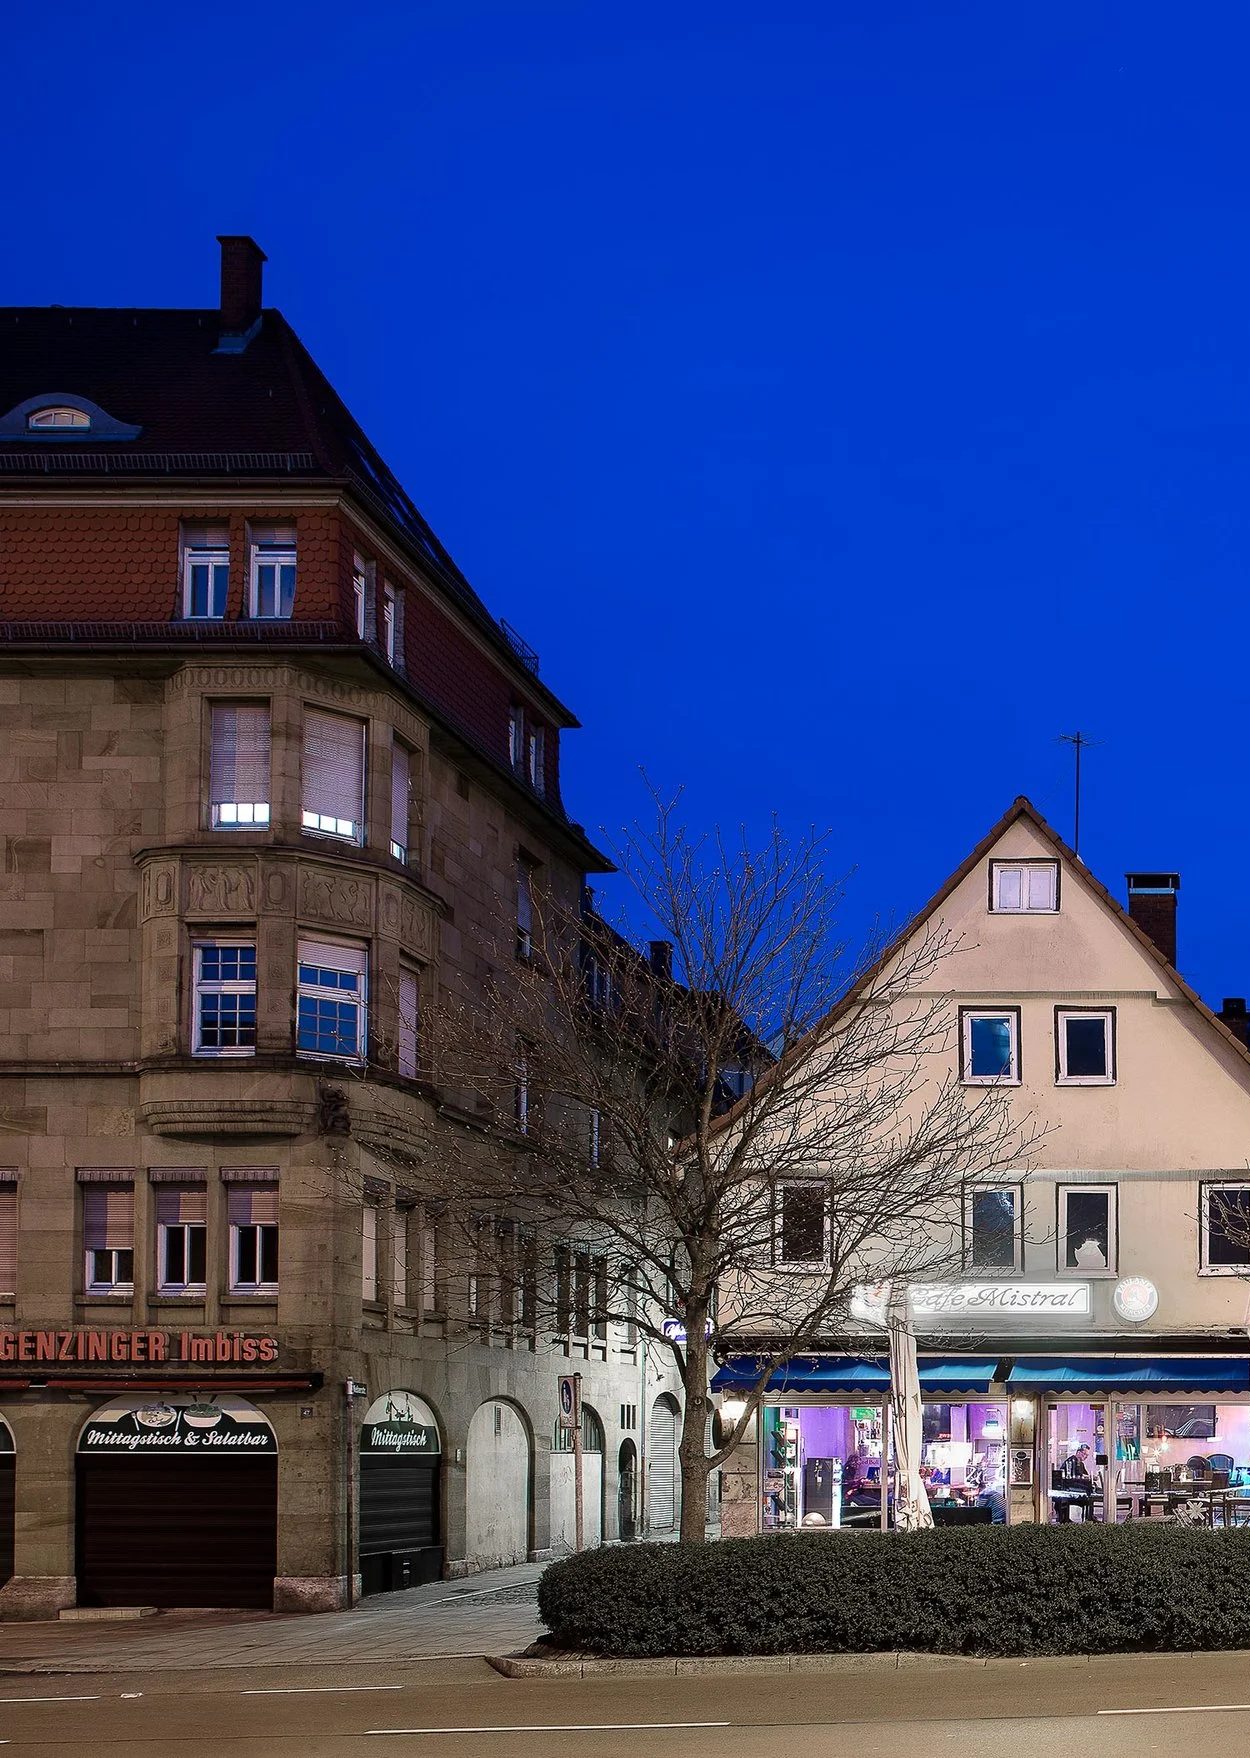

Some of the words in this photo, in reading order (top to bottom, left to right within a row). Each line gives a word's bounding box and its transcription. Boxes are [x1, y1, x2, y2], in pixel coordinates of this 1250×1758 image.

[968, 1287, 1086, 1307] Mistral
[0, 1331, 167, 1361] GENZINGER
[181, 1331, 279, 1361] Imbiss
[86, 1429, 182, 1451] Mittagstisch
[184, 1431, 200, 1446] &
[202, 1430, 268, 1447] Salatbar
[371, 1426, 428, 1452] Mittagstisch
